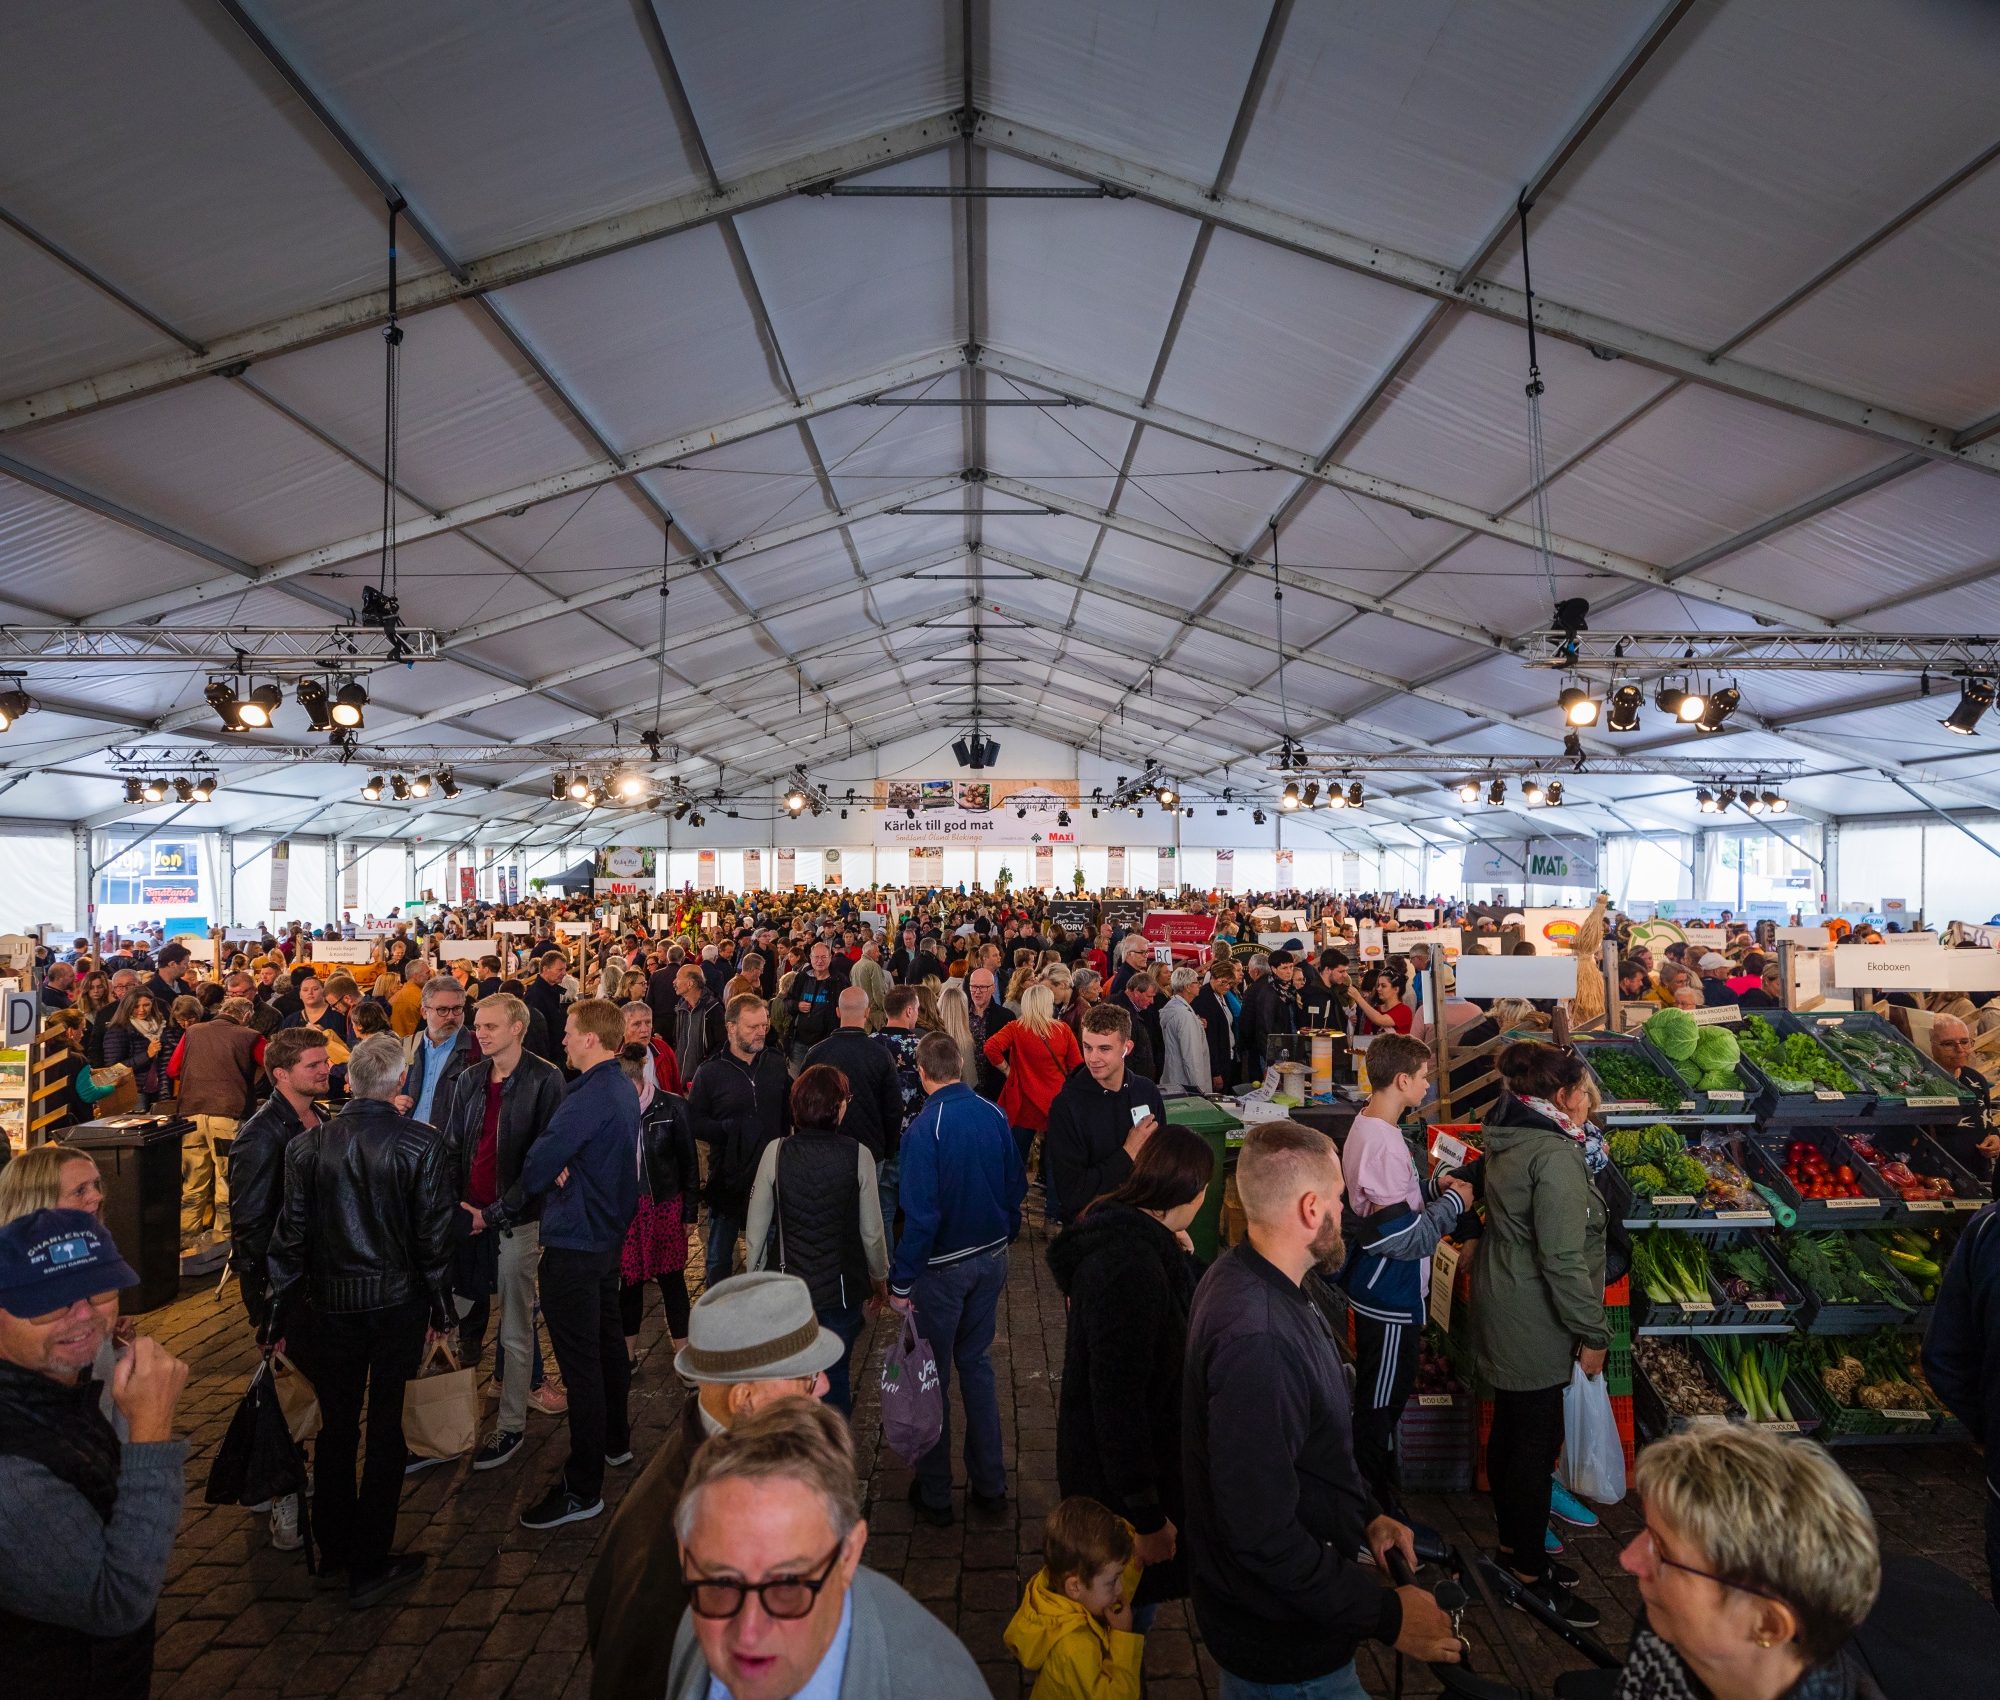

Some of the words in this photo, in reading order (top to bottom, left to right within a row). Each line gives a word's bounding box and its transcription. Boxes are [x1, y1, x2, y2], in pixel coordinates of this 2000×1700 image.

[884, 820, 922, 831] Kärlek
[926, 820, 941, 831] till
[944, 820, 967, 834] god
[970, 821, 994, 831] mat
[1867, 962, 1911, 972] Ekoboxen
[10, 998, 34, 1035] D
[27, 1230, 98, 1257] CHARLESTON
